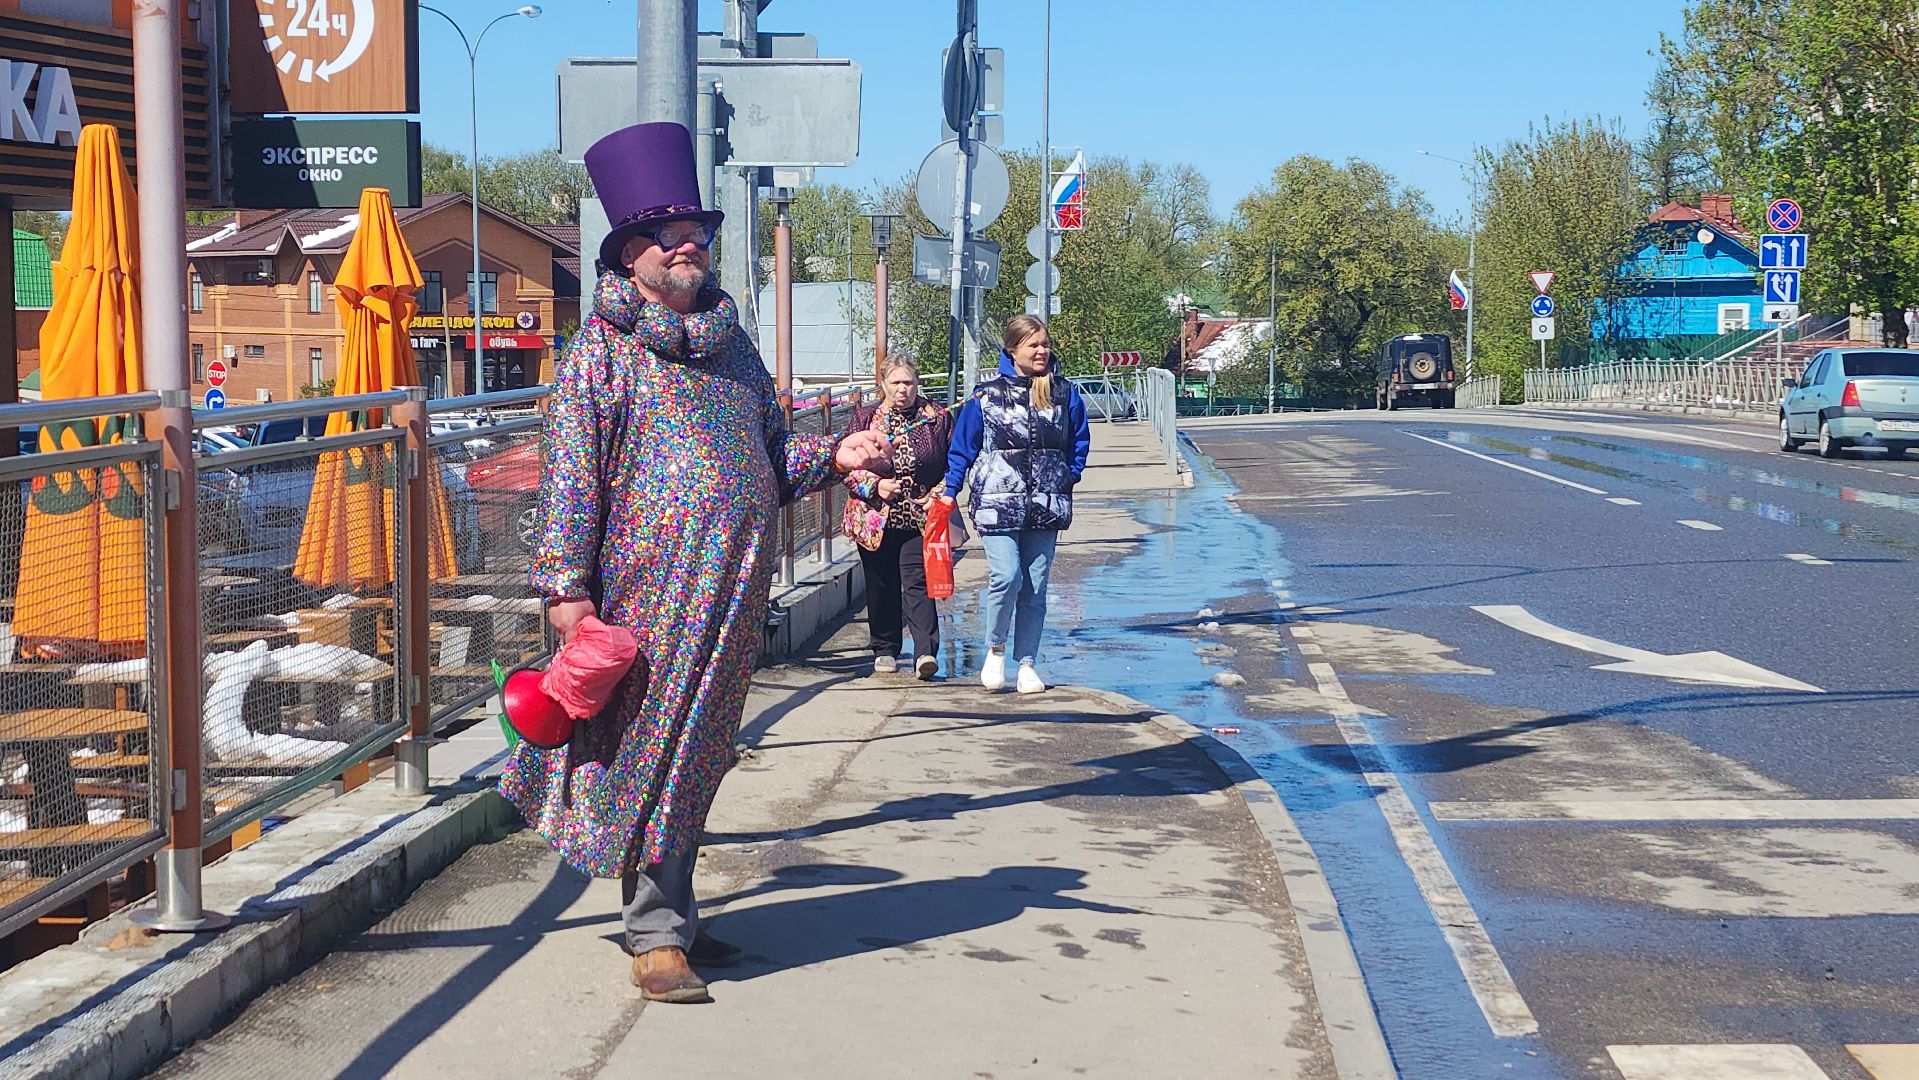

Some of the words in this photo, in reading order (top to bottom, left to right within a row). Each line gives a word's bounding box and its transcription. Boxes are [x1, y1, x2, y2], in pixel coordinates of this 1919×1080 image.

[286, 0, 348, 37] 24ч
[262, 146, 379, 165] ЭКСПРЕСС
[298, 168, 343, 182] ОКНО
[208, 369, 226, 380] STOP
